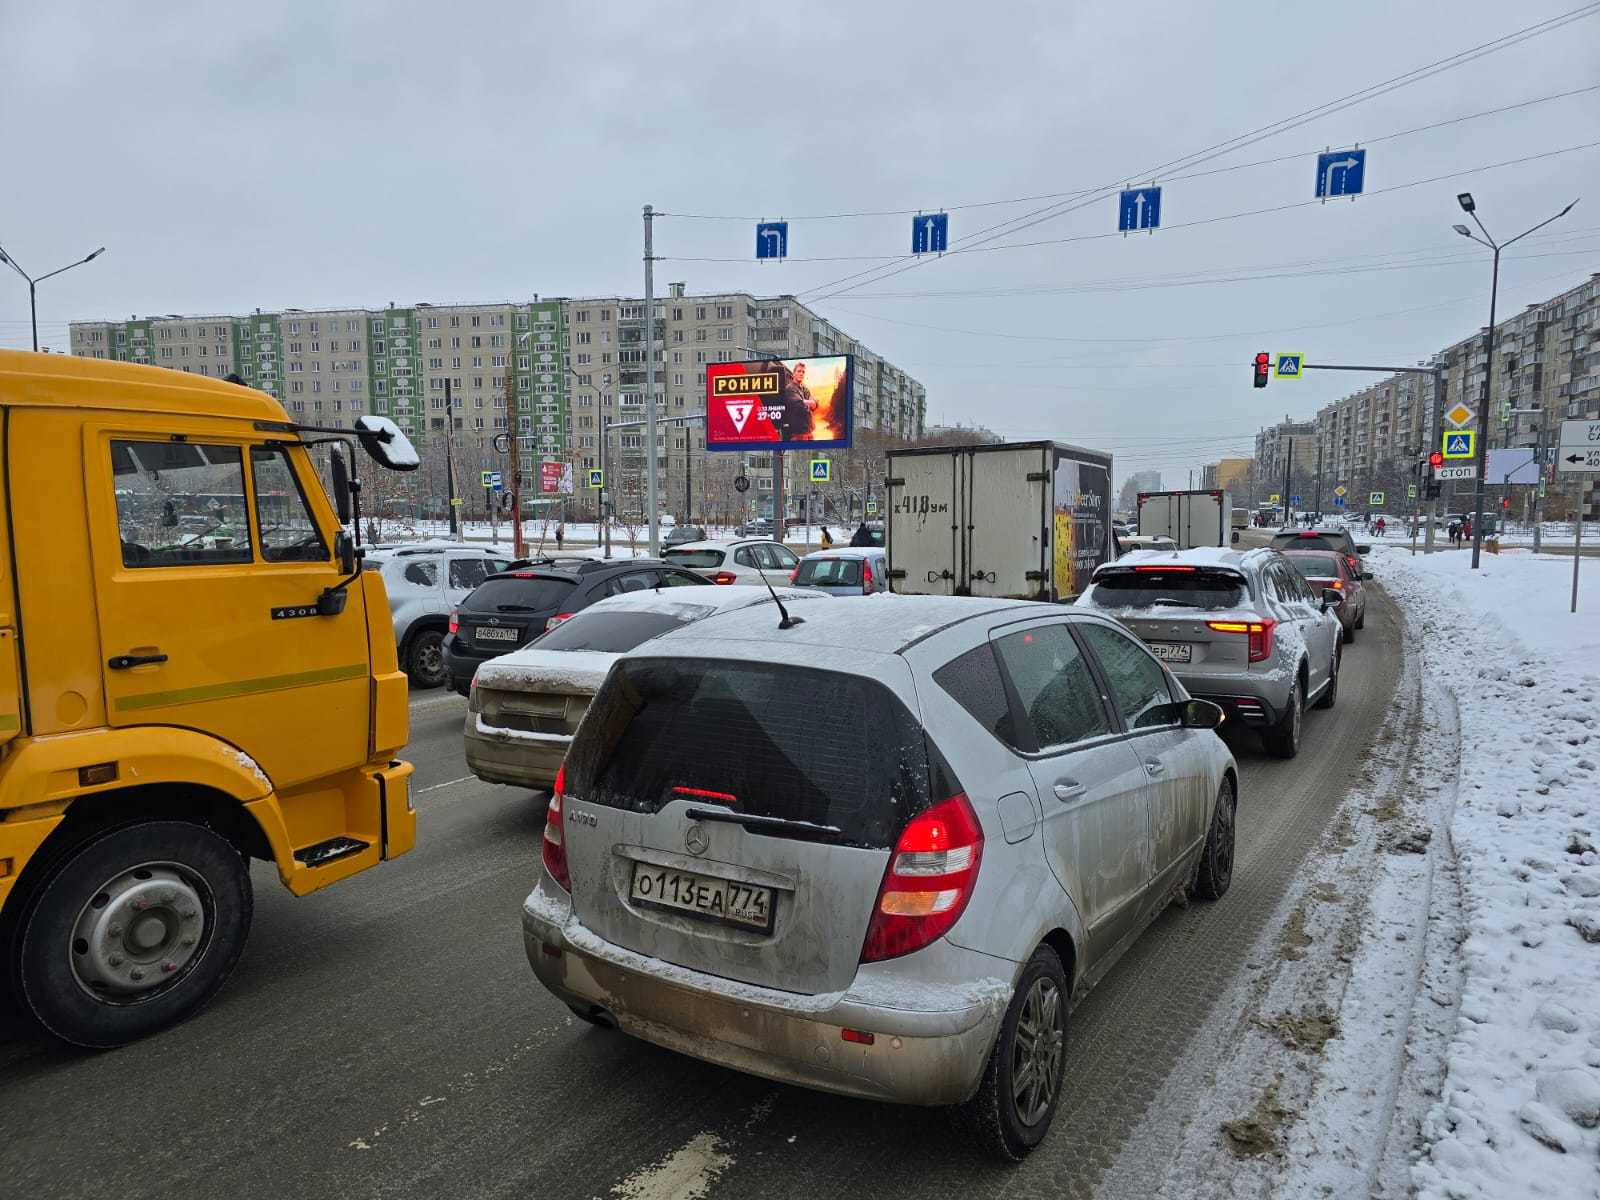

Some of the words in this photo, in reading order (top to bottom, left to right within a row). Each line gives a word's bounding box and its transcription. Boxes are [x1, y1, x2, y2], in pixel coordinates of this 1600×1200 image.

[718, 376, 773, 392] РОНИН
[735, 407, 744, 422] 3
[1441, 468, 1471, 478] СТОП
[277, 608, 317, 617] 4308
[729, 885, 765, 913] 774
